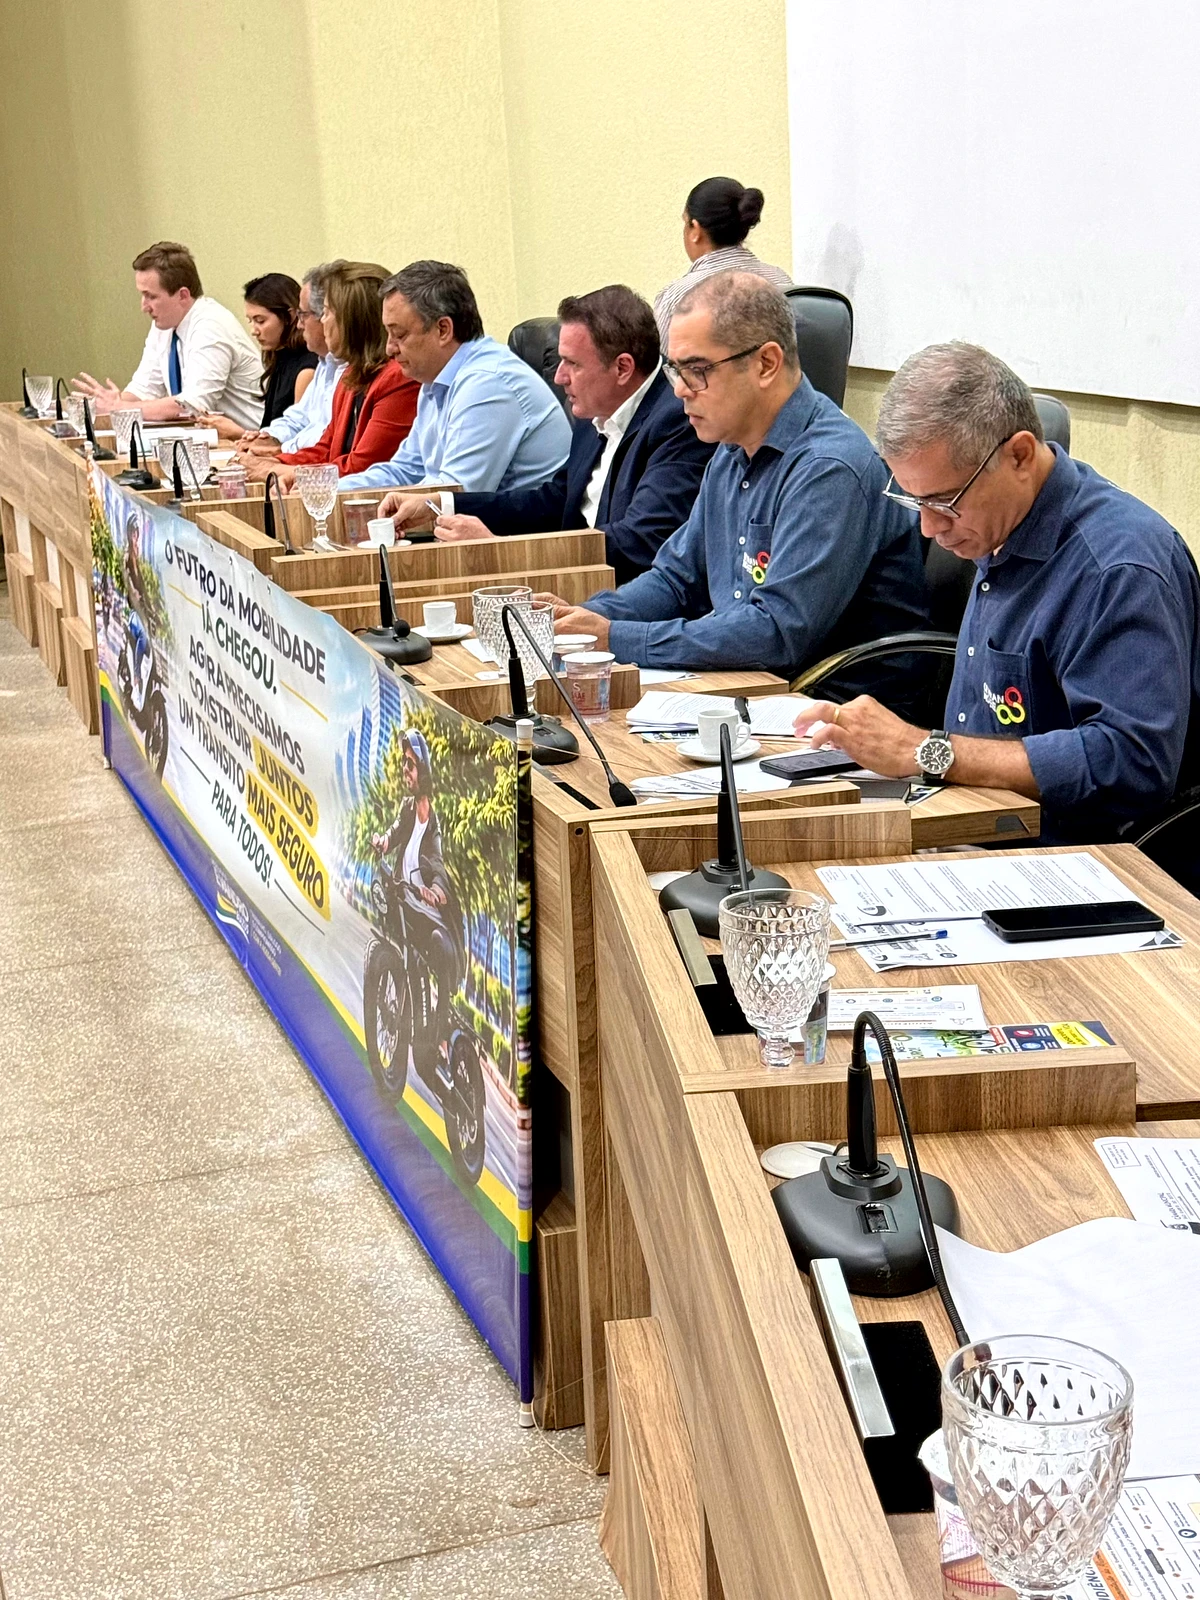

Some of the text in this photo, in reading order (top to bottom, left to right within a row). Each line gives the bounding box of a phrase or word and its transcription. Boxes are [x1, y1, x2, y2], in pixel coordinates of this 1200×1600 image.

[165, 540, 325, 684] O FUTRO DA MOBILIDADE
[215, 617, 277, 694] CHEGOU.
[189, 635, 305, 775] AGRA PRECISAMOS
[178, 693, 324, 908] UM TRÂNSITO MAIS SEGURO
[211, 780, 237, 834] PARA
[237, 813, 273, 888] TODOS!
[259, 746, 313, 827] JUNTOS
